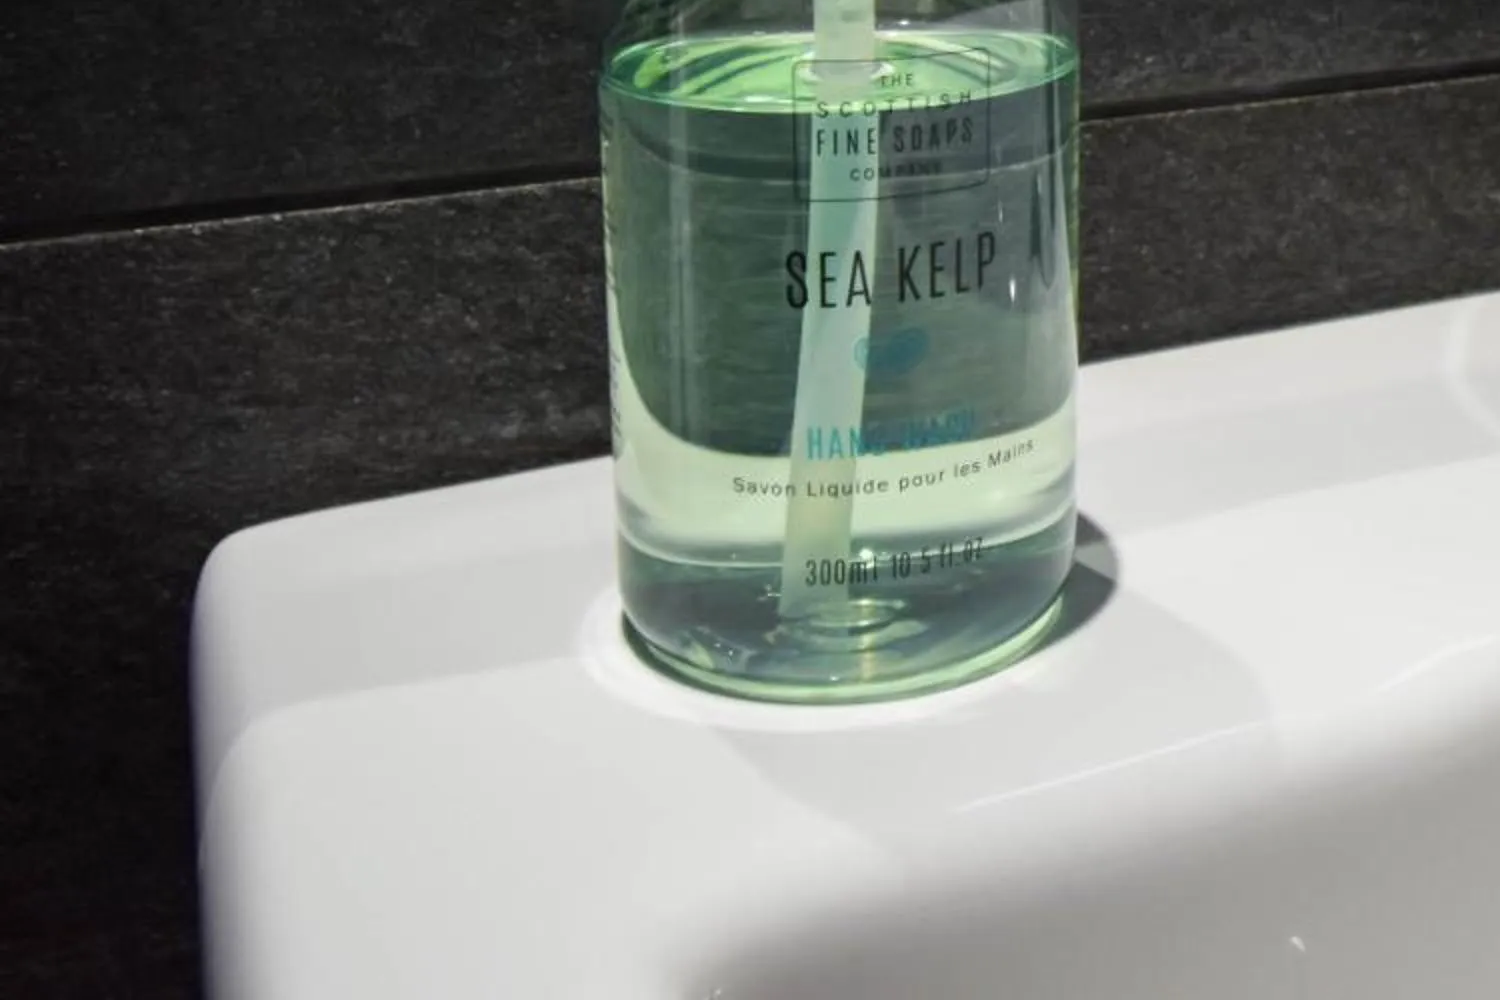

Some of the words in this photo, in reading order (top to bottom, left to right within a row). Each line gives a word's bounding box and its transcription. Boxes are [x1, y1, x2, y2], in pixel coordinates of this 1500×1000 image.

[880, 73, 913, 88] THE
[816, 89, 972, 119] SCOTTISH
[816, 127, 877, 156] FINE
[893, 116, 974, 152] SOAPS
[785, 250, 872, 309] SEA
[899, 231, 996, 302] KELP
[806, 423, 886, 460] HAN
[732, 477, 797, 497] Savon
[807, 479, 889, 498] Liquide
[899, 469, 945, 493] pour
[954, 463, 981, 478] les
[987, 439, 1034, 468] Mains
[805, 554, 878, 586] 300ml
